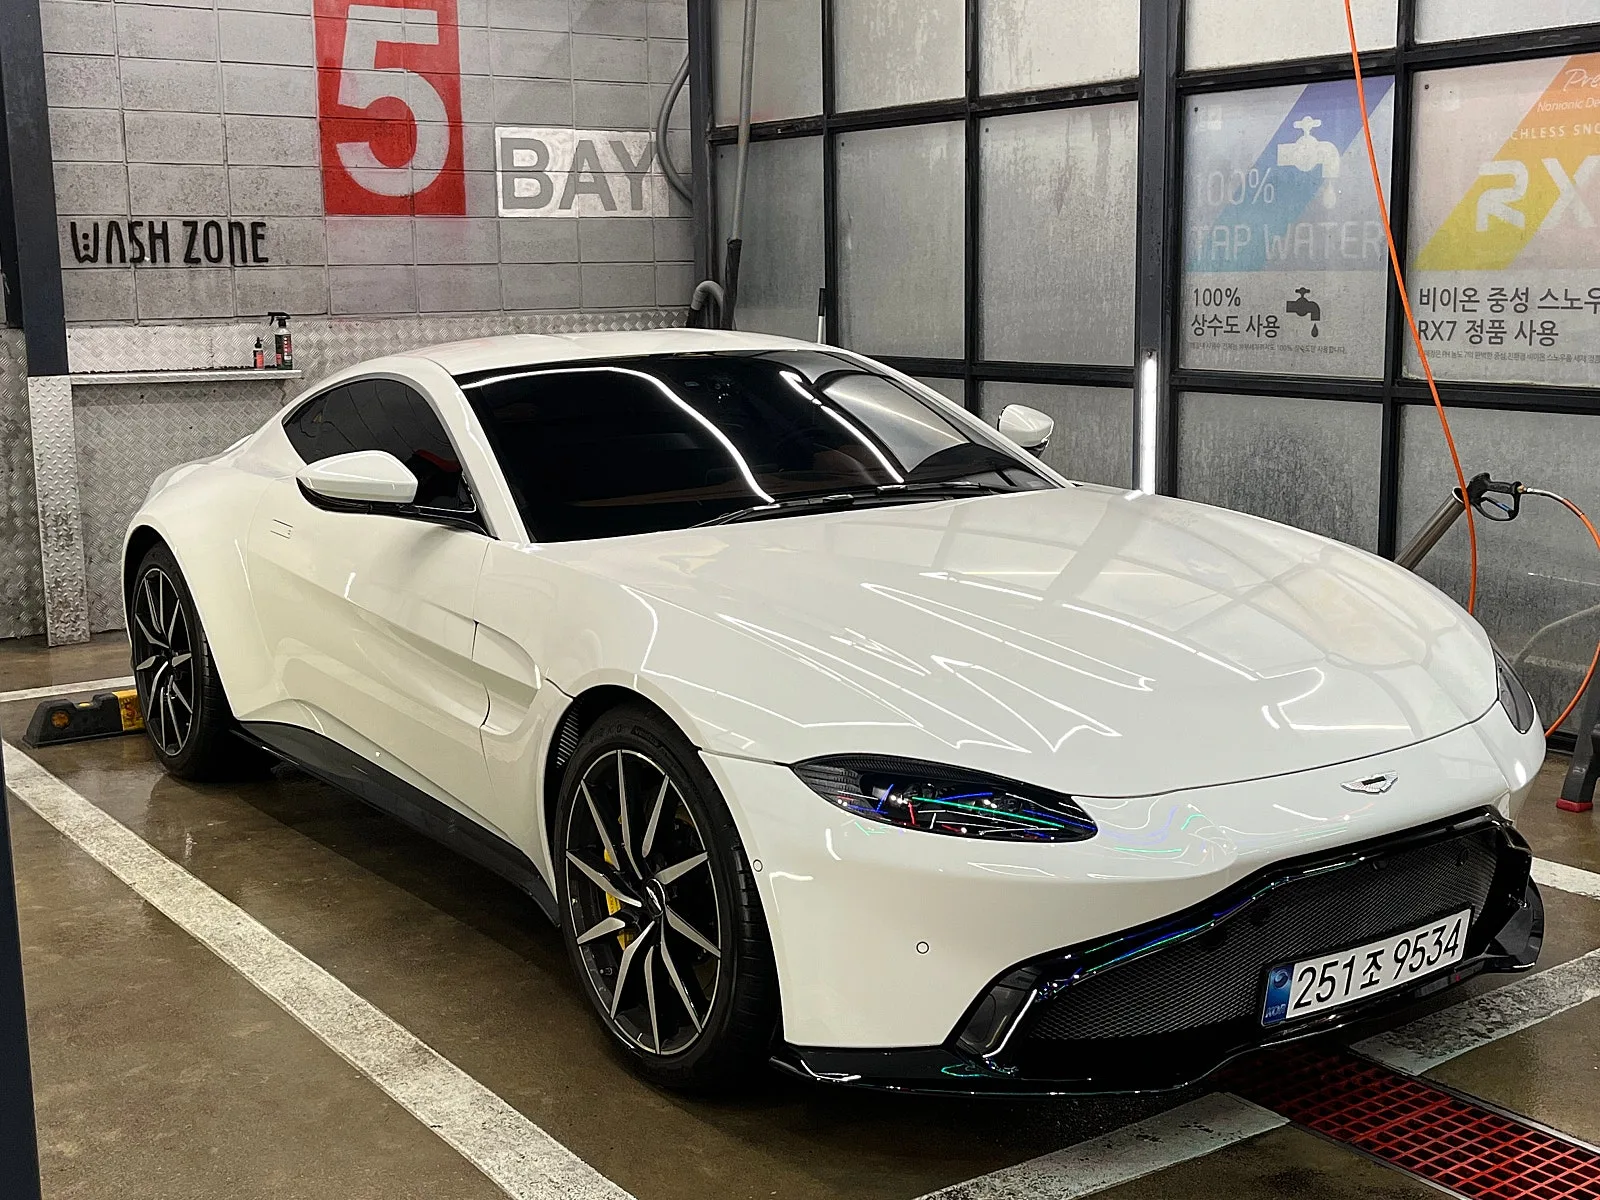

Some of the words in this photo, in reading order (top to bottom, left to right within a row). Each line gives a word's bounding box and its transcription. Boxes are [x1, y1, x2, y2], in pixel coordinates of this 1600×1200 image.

[336, 4, 450, 197] 5
[500, 137, 658, 212] BAY
[1194, 167, 1275, 207] 100%
[70, 220, 170, 264] WASH
[182, 220, 269, 264] ZONE
[1192, 223, 1251, 262] TAP
[1263, 219, 1383, 262] WATER
[1193, 287, 1241, 307] 100%
[1419, 286, 1481, 313] 비이온
[1486, 286, 1530, 314] 중성
[1191, 313, 1241, 337] 상수도
[1246, 314, 1281, 338] 사용
[1418, 320, 1457, 342] RX7
[1465, 319, 1508, 346] 정품
[1514, 319, 1559, 347] 사용
[1292, 948, 1385, 1010] 251조
[1392, 917, 1462, 981] 9534
